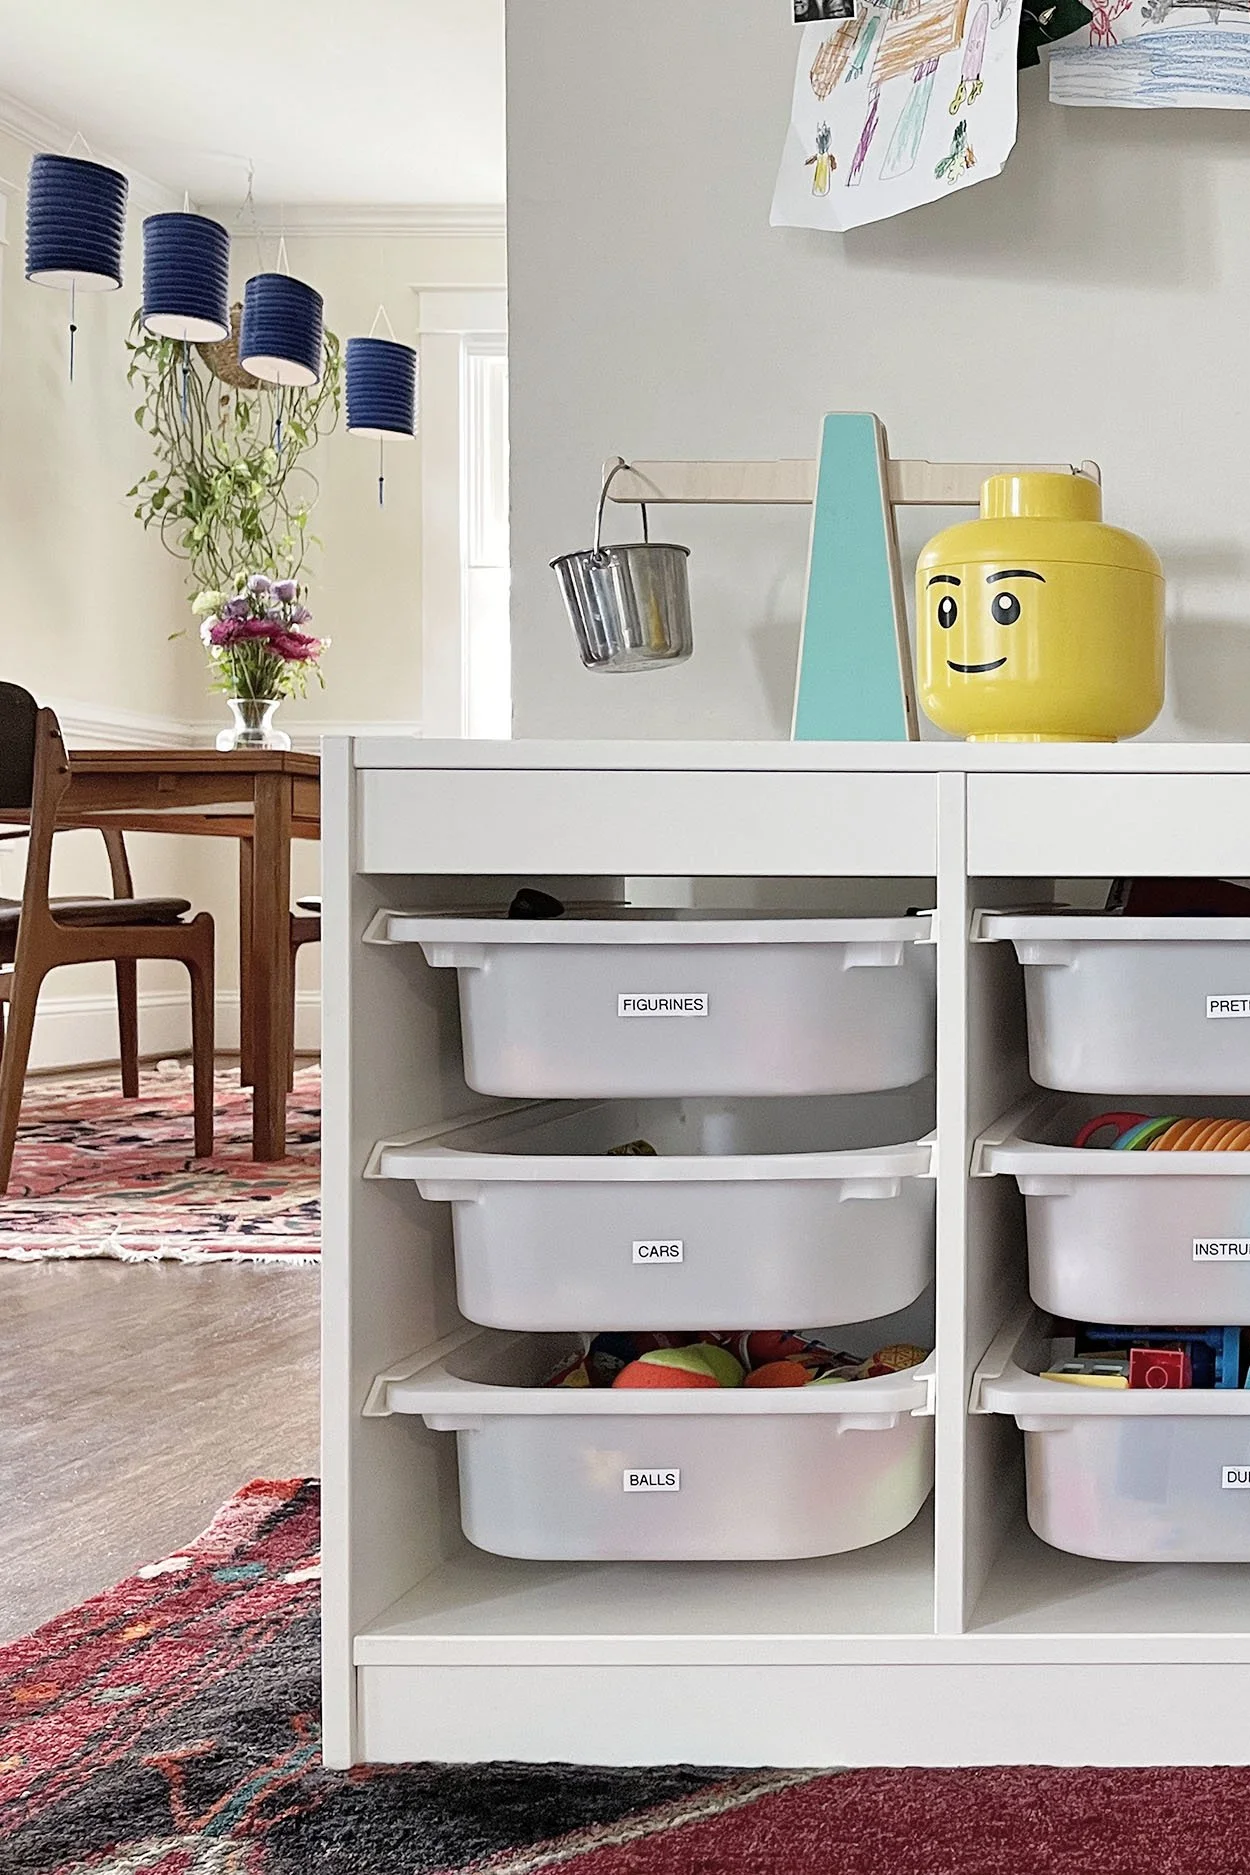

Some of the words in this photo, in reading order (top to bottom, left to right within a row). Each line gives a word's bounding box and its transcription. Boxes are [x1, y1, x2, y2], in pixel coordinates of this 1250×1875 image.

[623, 999, 704, 1011] FIGURINES
[638, 1244, 680, 1258] CARS
[629, 1473, 676, 1486] BALLS
